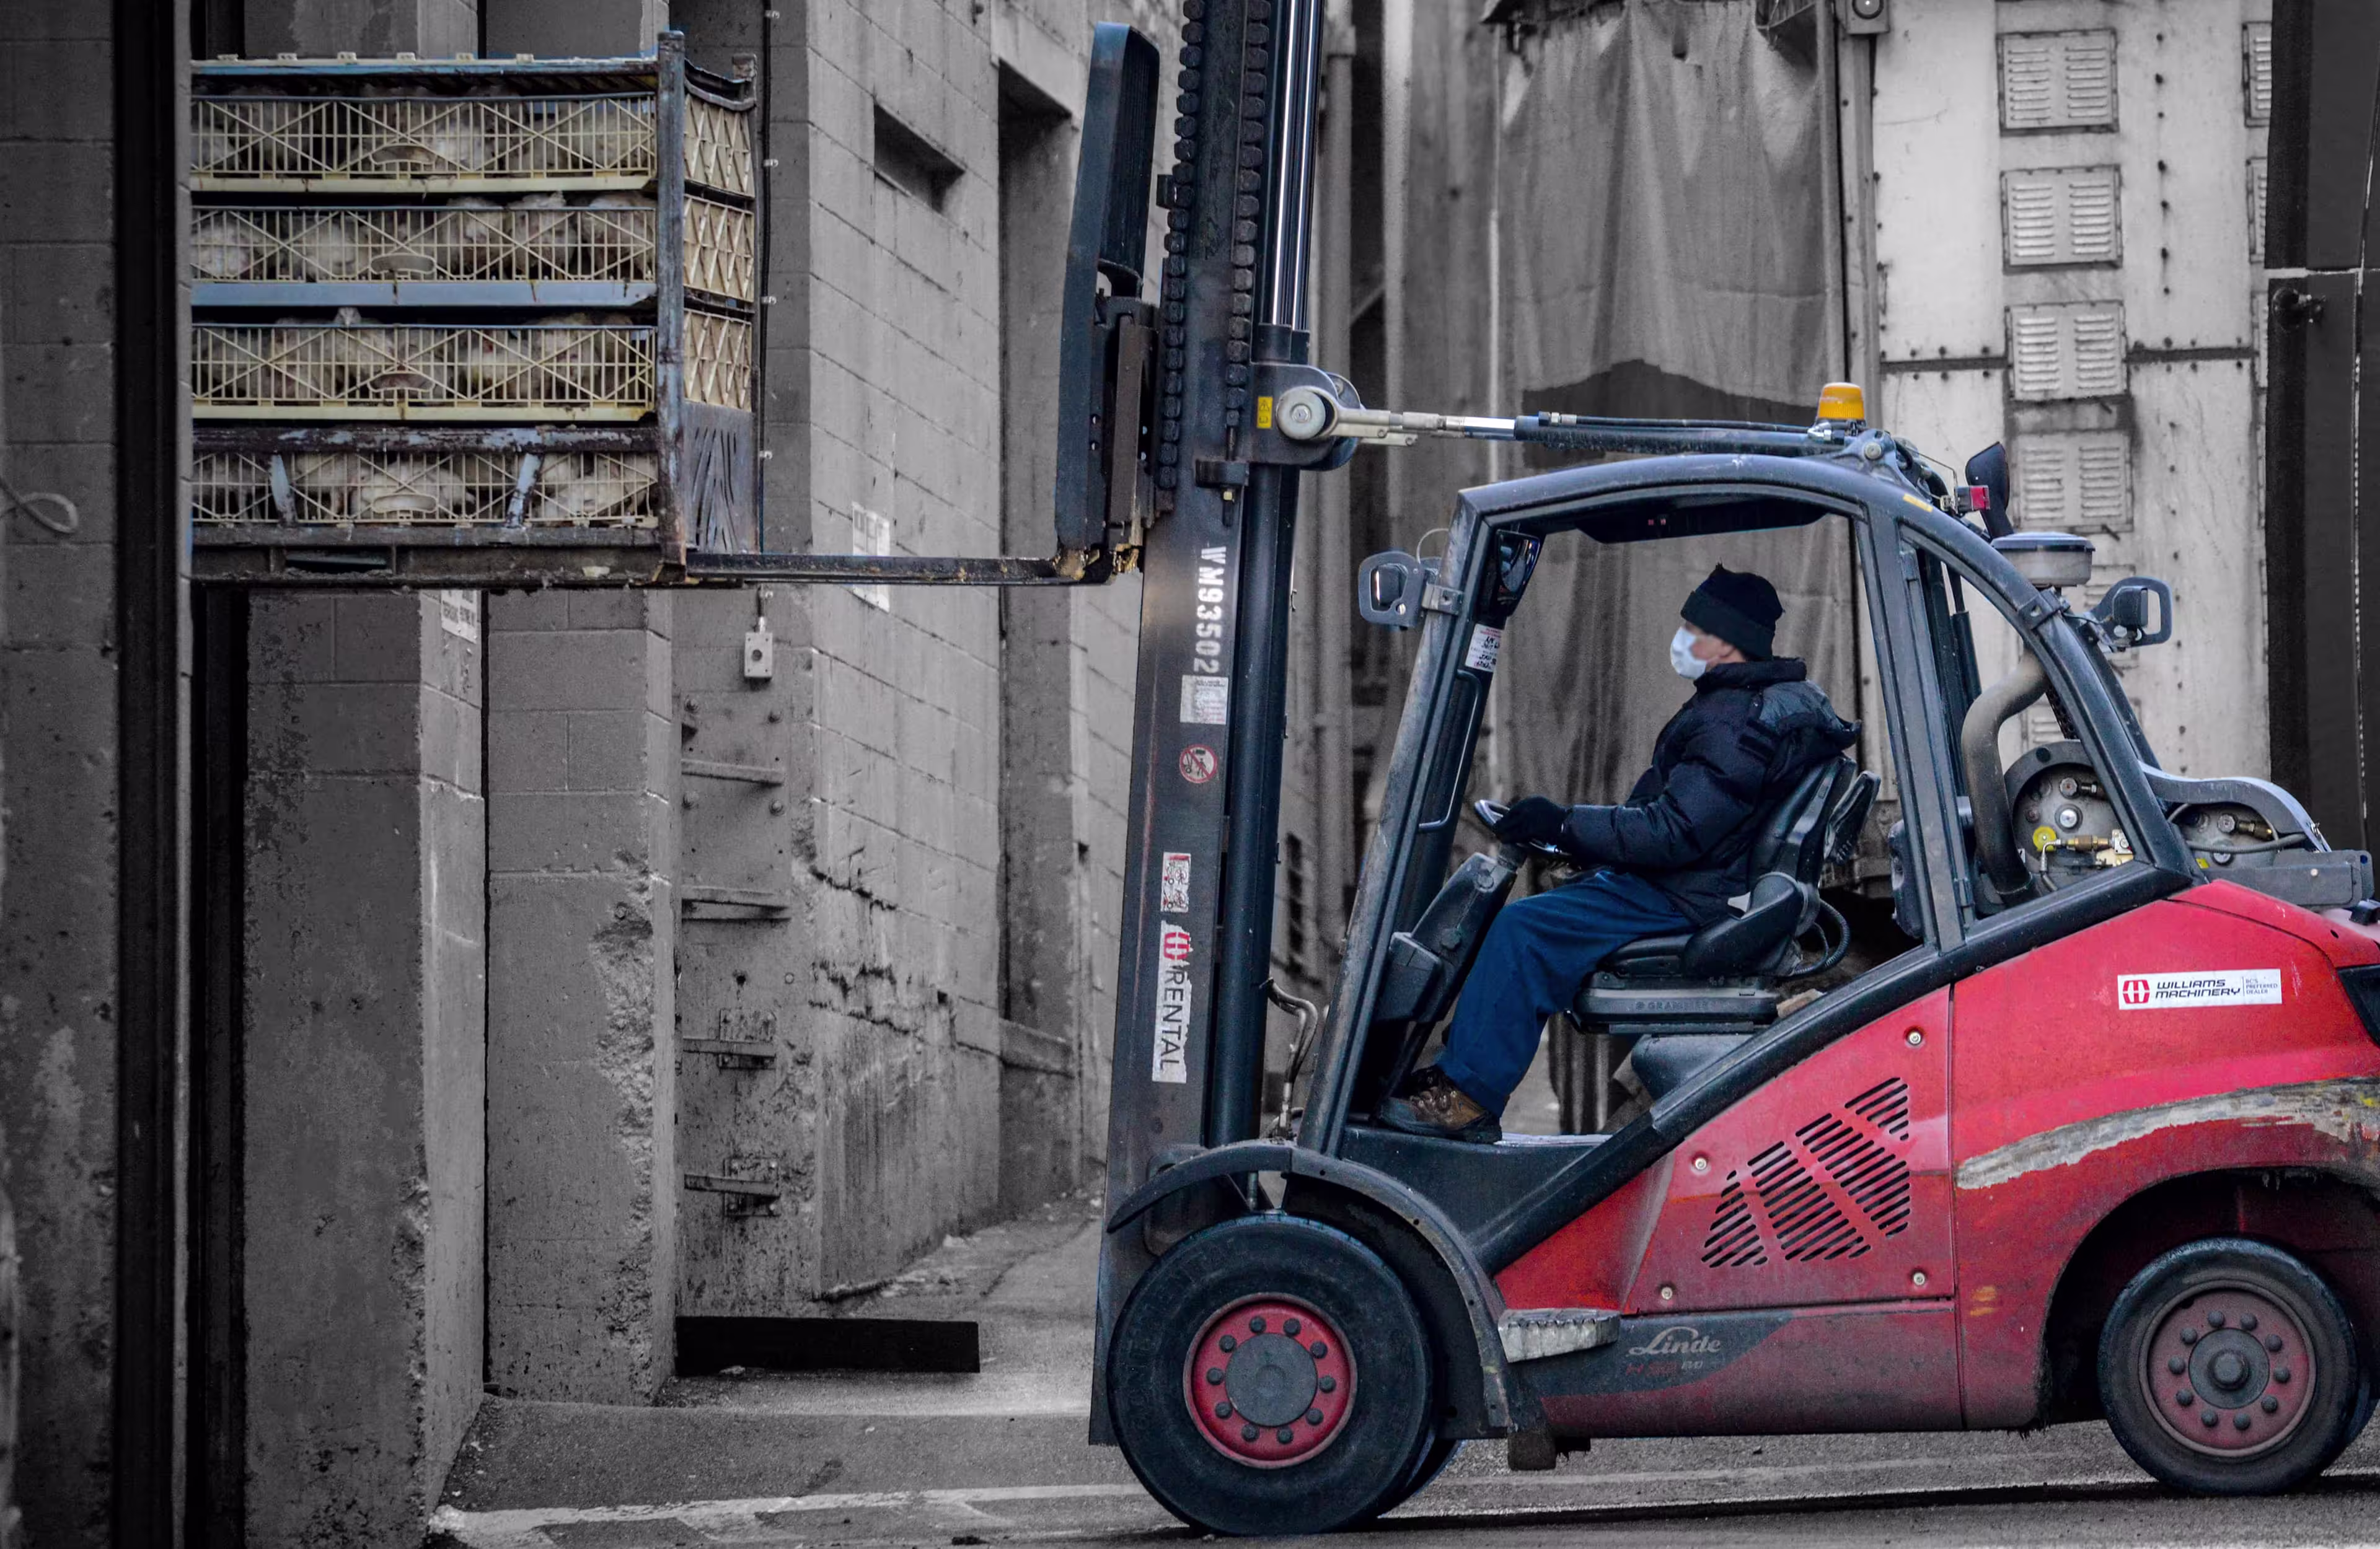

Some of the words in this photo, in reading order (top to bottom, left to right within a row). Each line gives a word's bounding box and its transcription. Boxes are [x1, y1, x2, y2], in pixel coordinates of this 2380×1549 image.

[1194, 546, 1227, 674] WM93502
[2155, 988, 2241, 998] MACHINERY
[2157, 979, 2226, 989] WILLIAMS
[1160, 967, 1185, 1071] RENTAL
[1627, 1326, 1721, 1356] Linde
